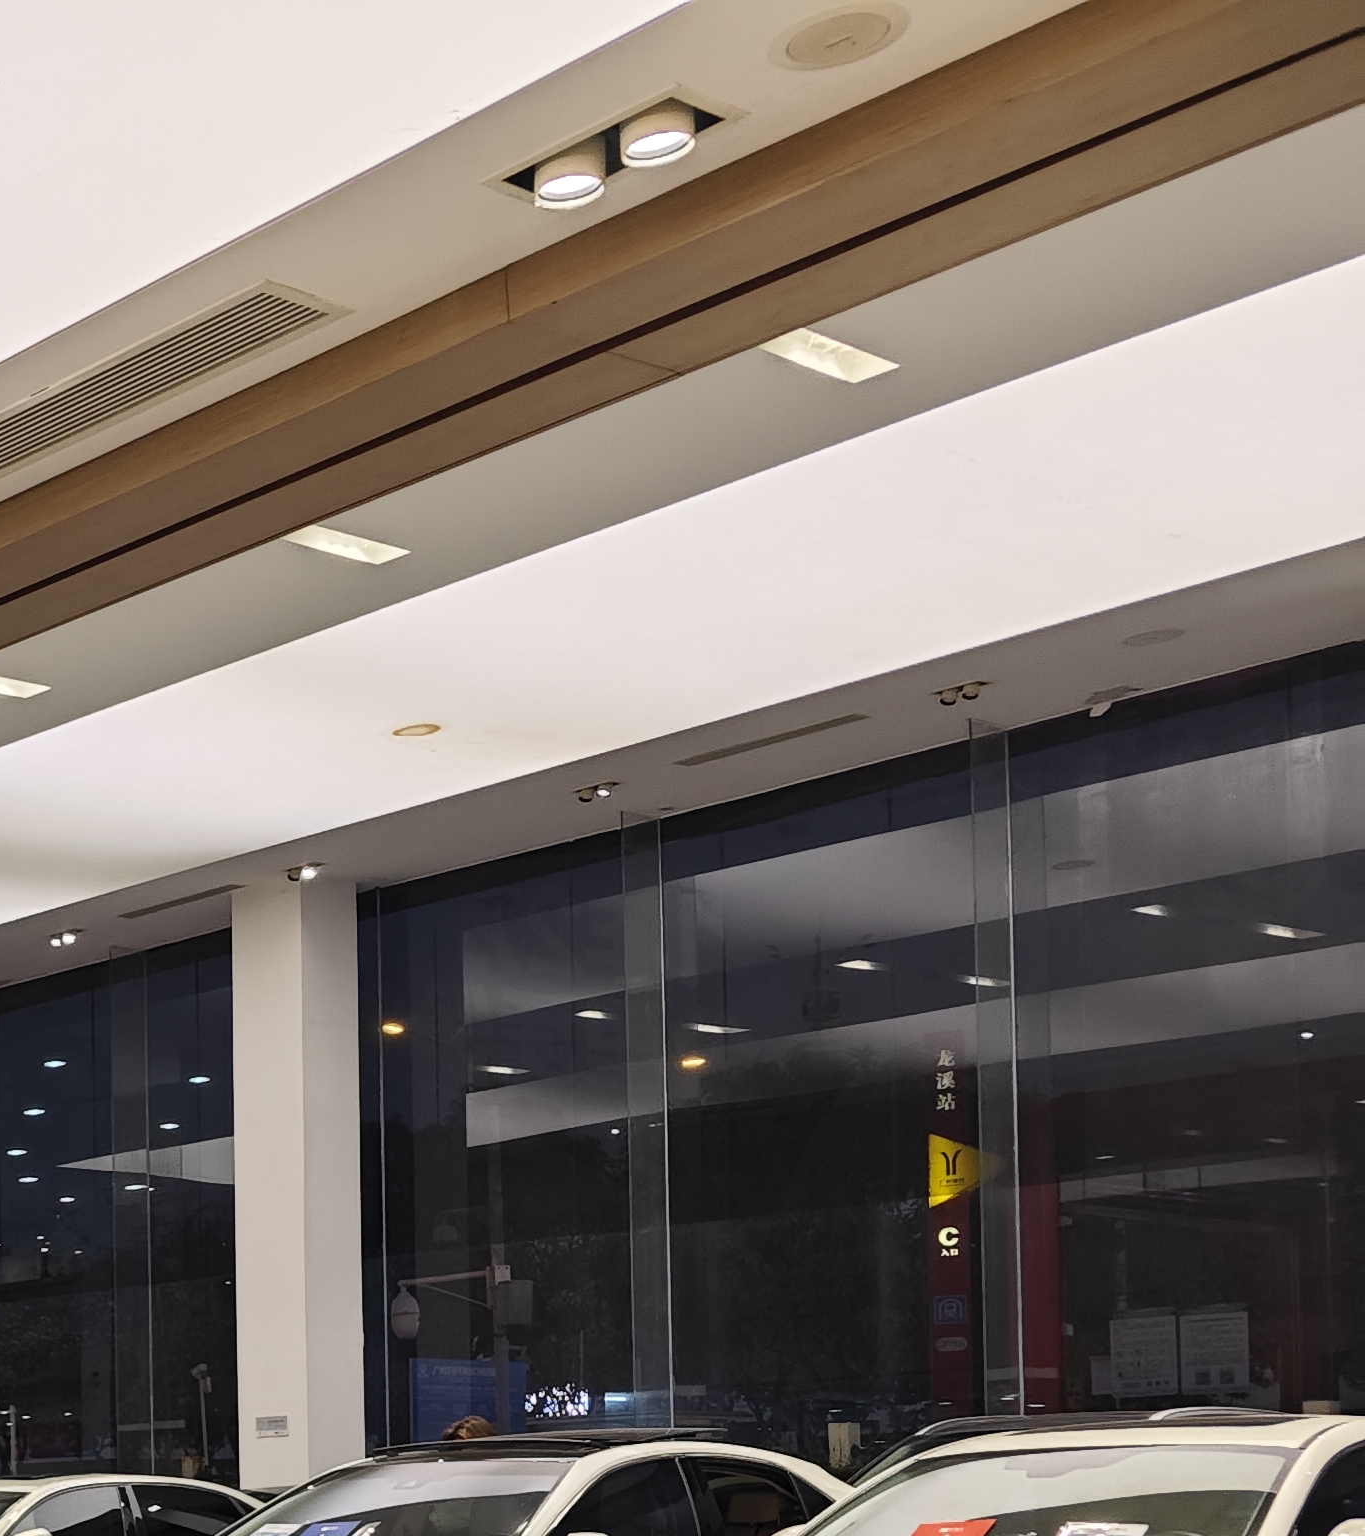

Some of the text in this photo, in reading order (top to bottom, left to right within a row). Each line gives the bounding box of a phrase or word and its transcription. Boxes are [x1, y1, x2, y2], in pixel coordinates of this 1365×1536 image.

[935, 1049, 957, 1111] 龙溪站
[938, 1226, 961, 1247] C
